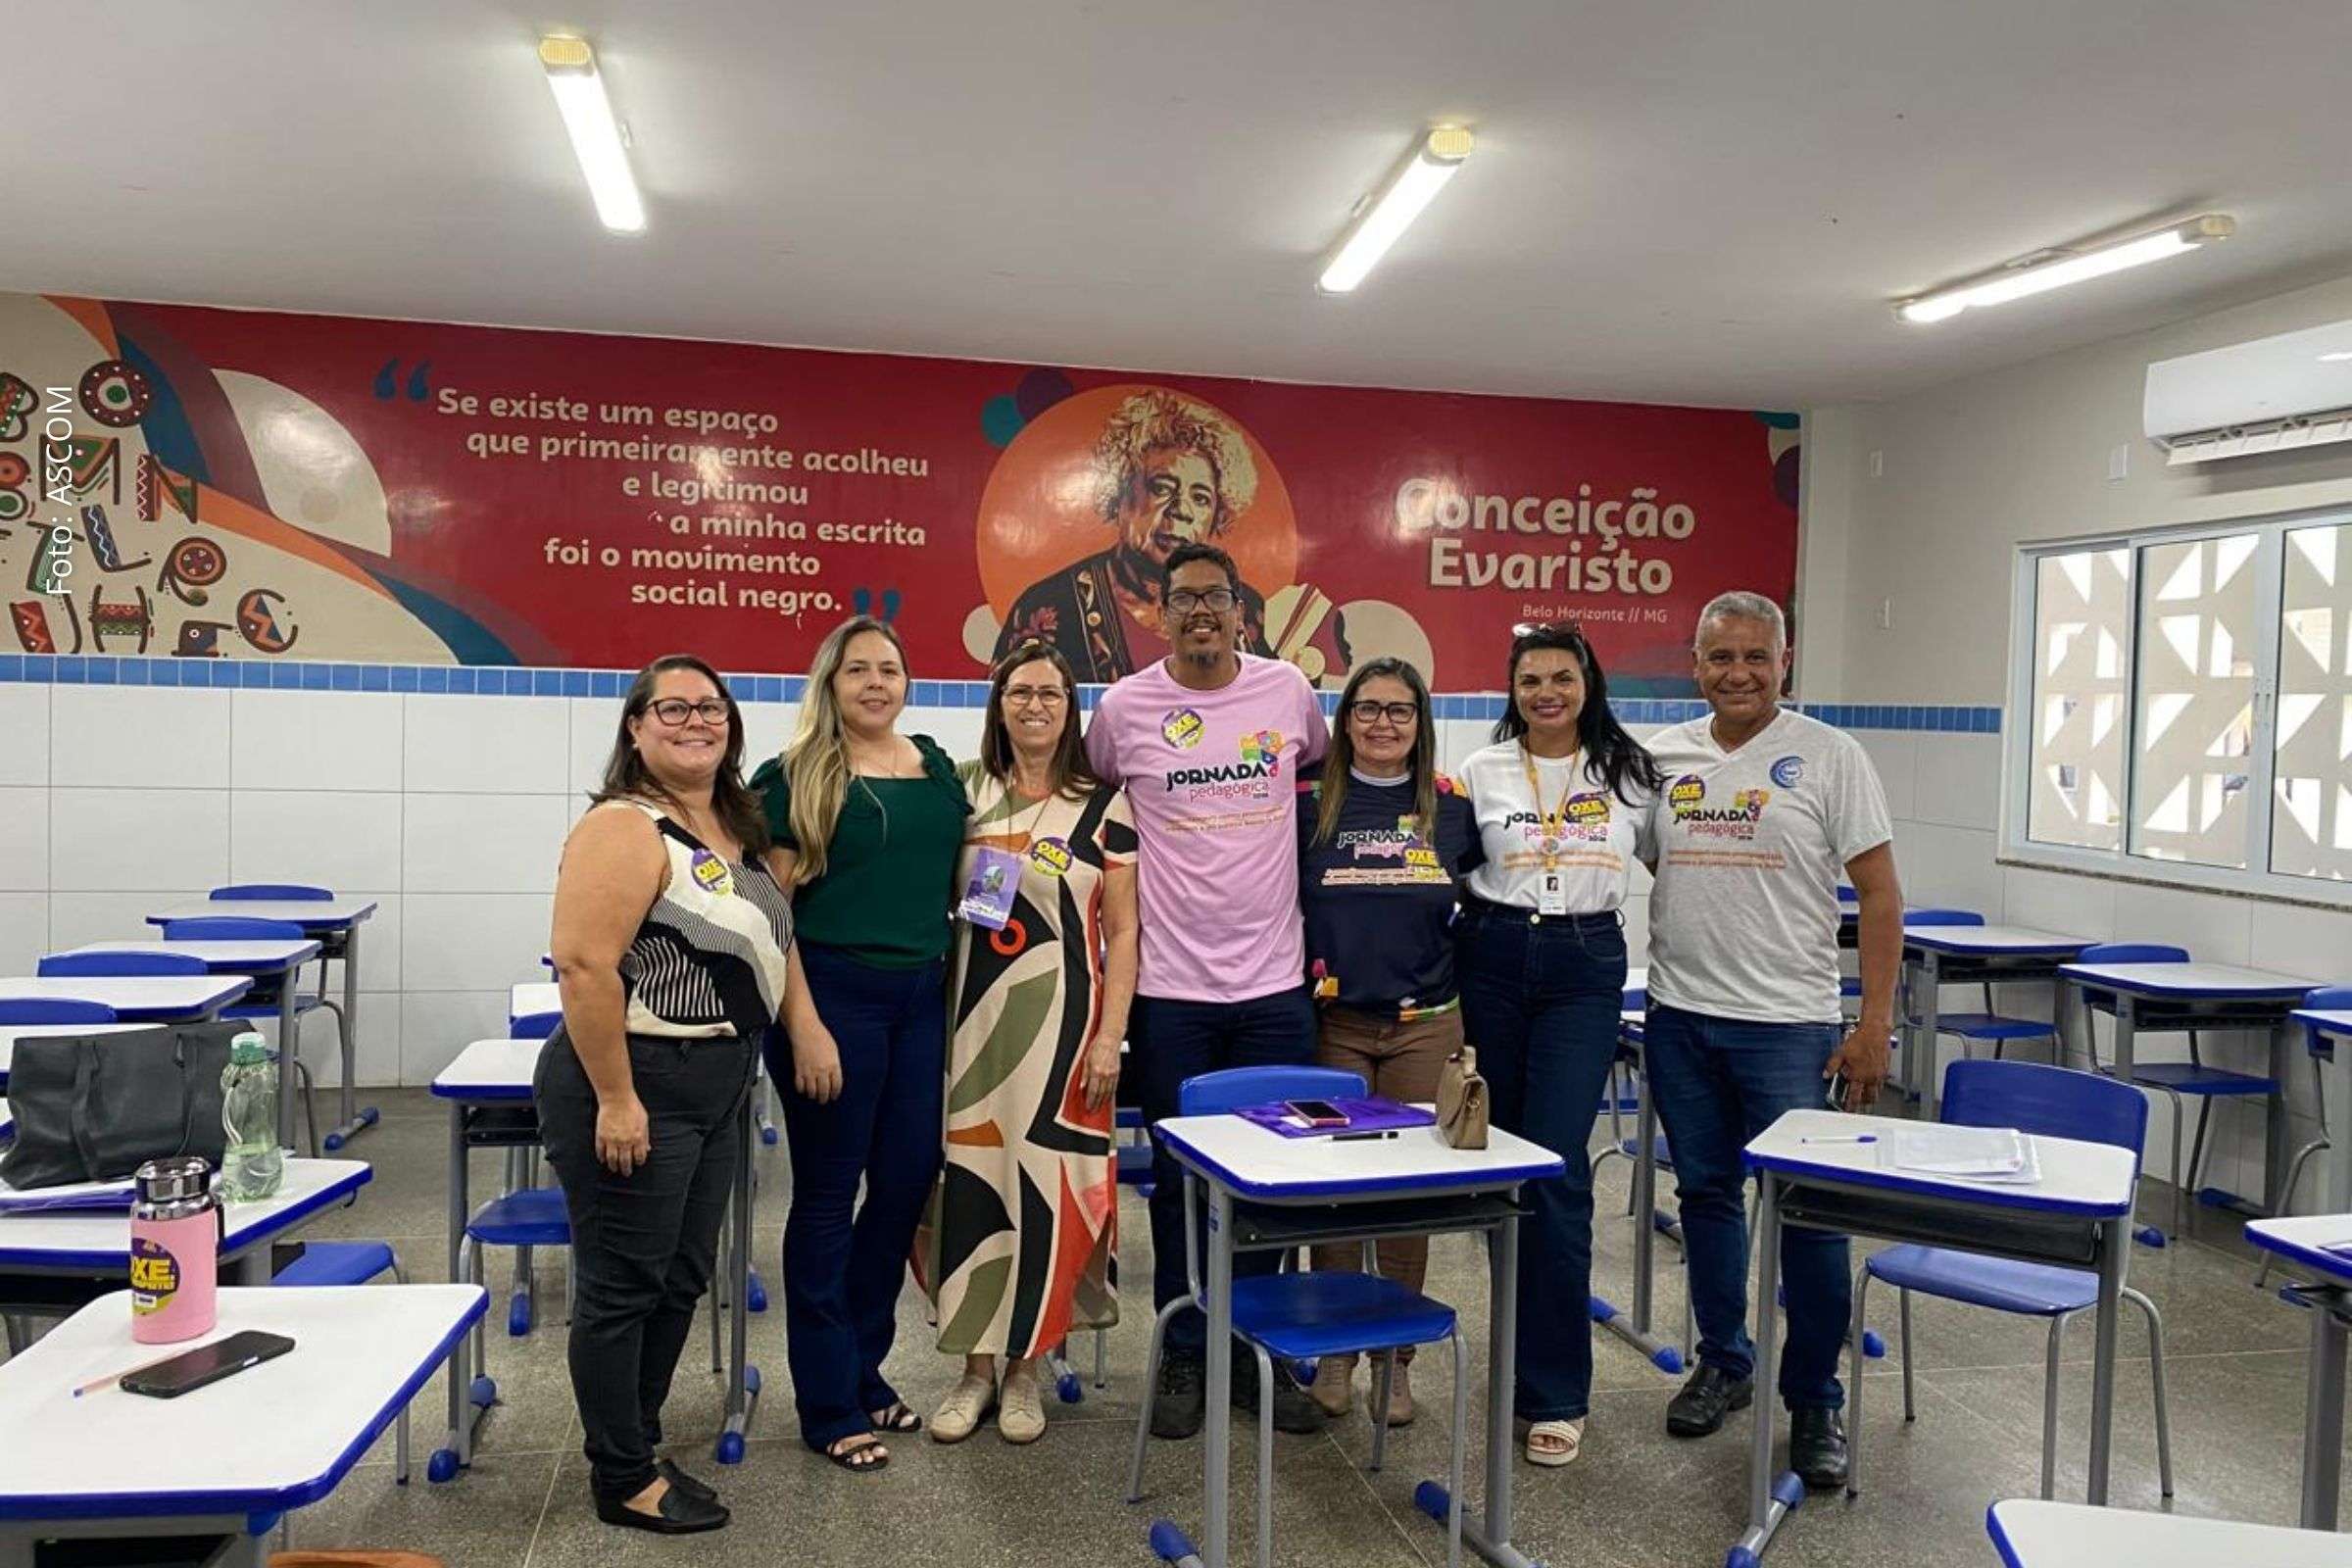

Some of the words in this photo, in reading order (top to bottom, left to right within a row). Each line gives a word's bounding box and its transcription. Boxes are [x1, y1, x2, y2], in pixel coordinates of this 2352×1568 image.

[437, 388, 477, 416] Se
[489, 392, 589, 421] existe
[599, 401, 654, 426] um
[663, 407, 779, 440] espaço
[466, 432, 529, 460] que
[540, 433, 793, 470] primeiramente
[803, 448, 929, 477] acolheu
[622, 476, 640, 497] e
[651, 470, 808, 506] legitimou
[669, 514, 689, 535] a
[701, 508, 807, 541] minha
[816, 514, 926, 546] escrita
[1396, 477, 1695, 551] Conceição
[544, 538, 590, 564] foi
[601, 547, 620, 566] o
[631, 544, 821, 576] movimento
[1430, 536, 1672, 594] Evaristo
[631, 580, 728, 606] social
[739, 584, 842, 615] negro.
[1522, 604, 1553, 619] Belo
[1557, 606, 1624, 623] Horizonte
[1643, 609, 1668, 624] MG
[1166, 762, 1268, 792] JORNADA
[1674, 809, 1752, 825] JORNADA
